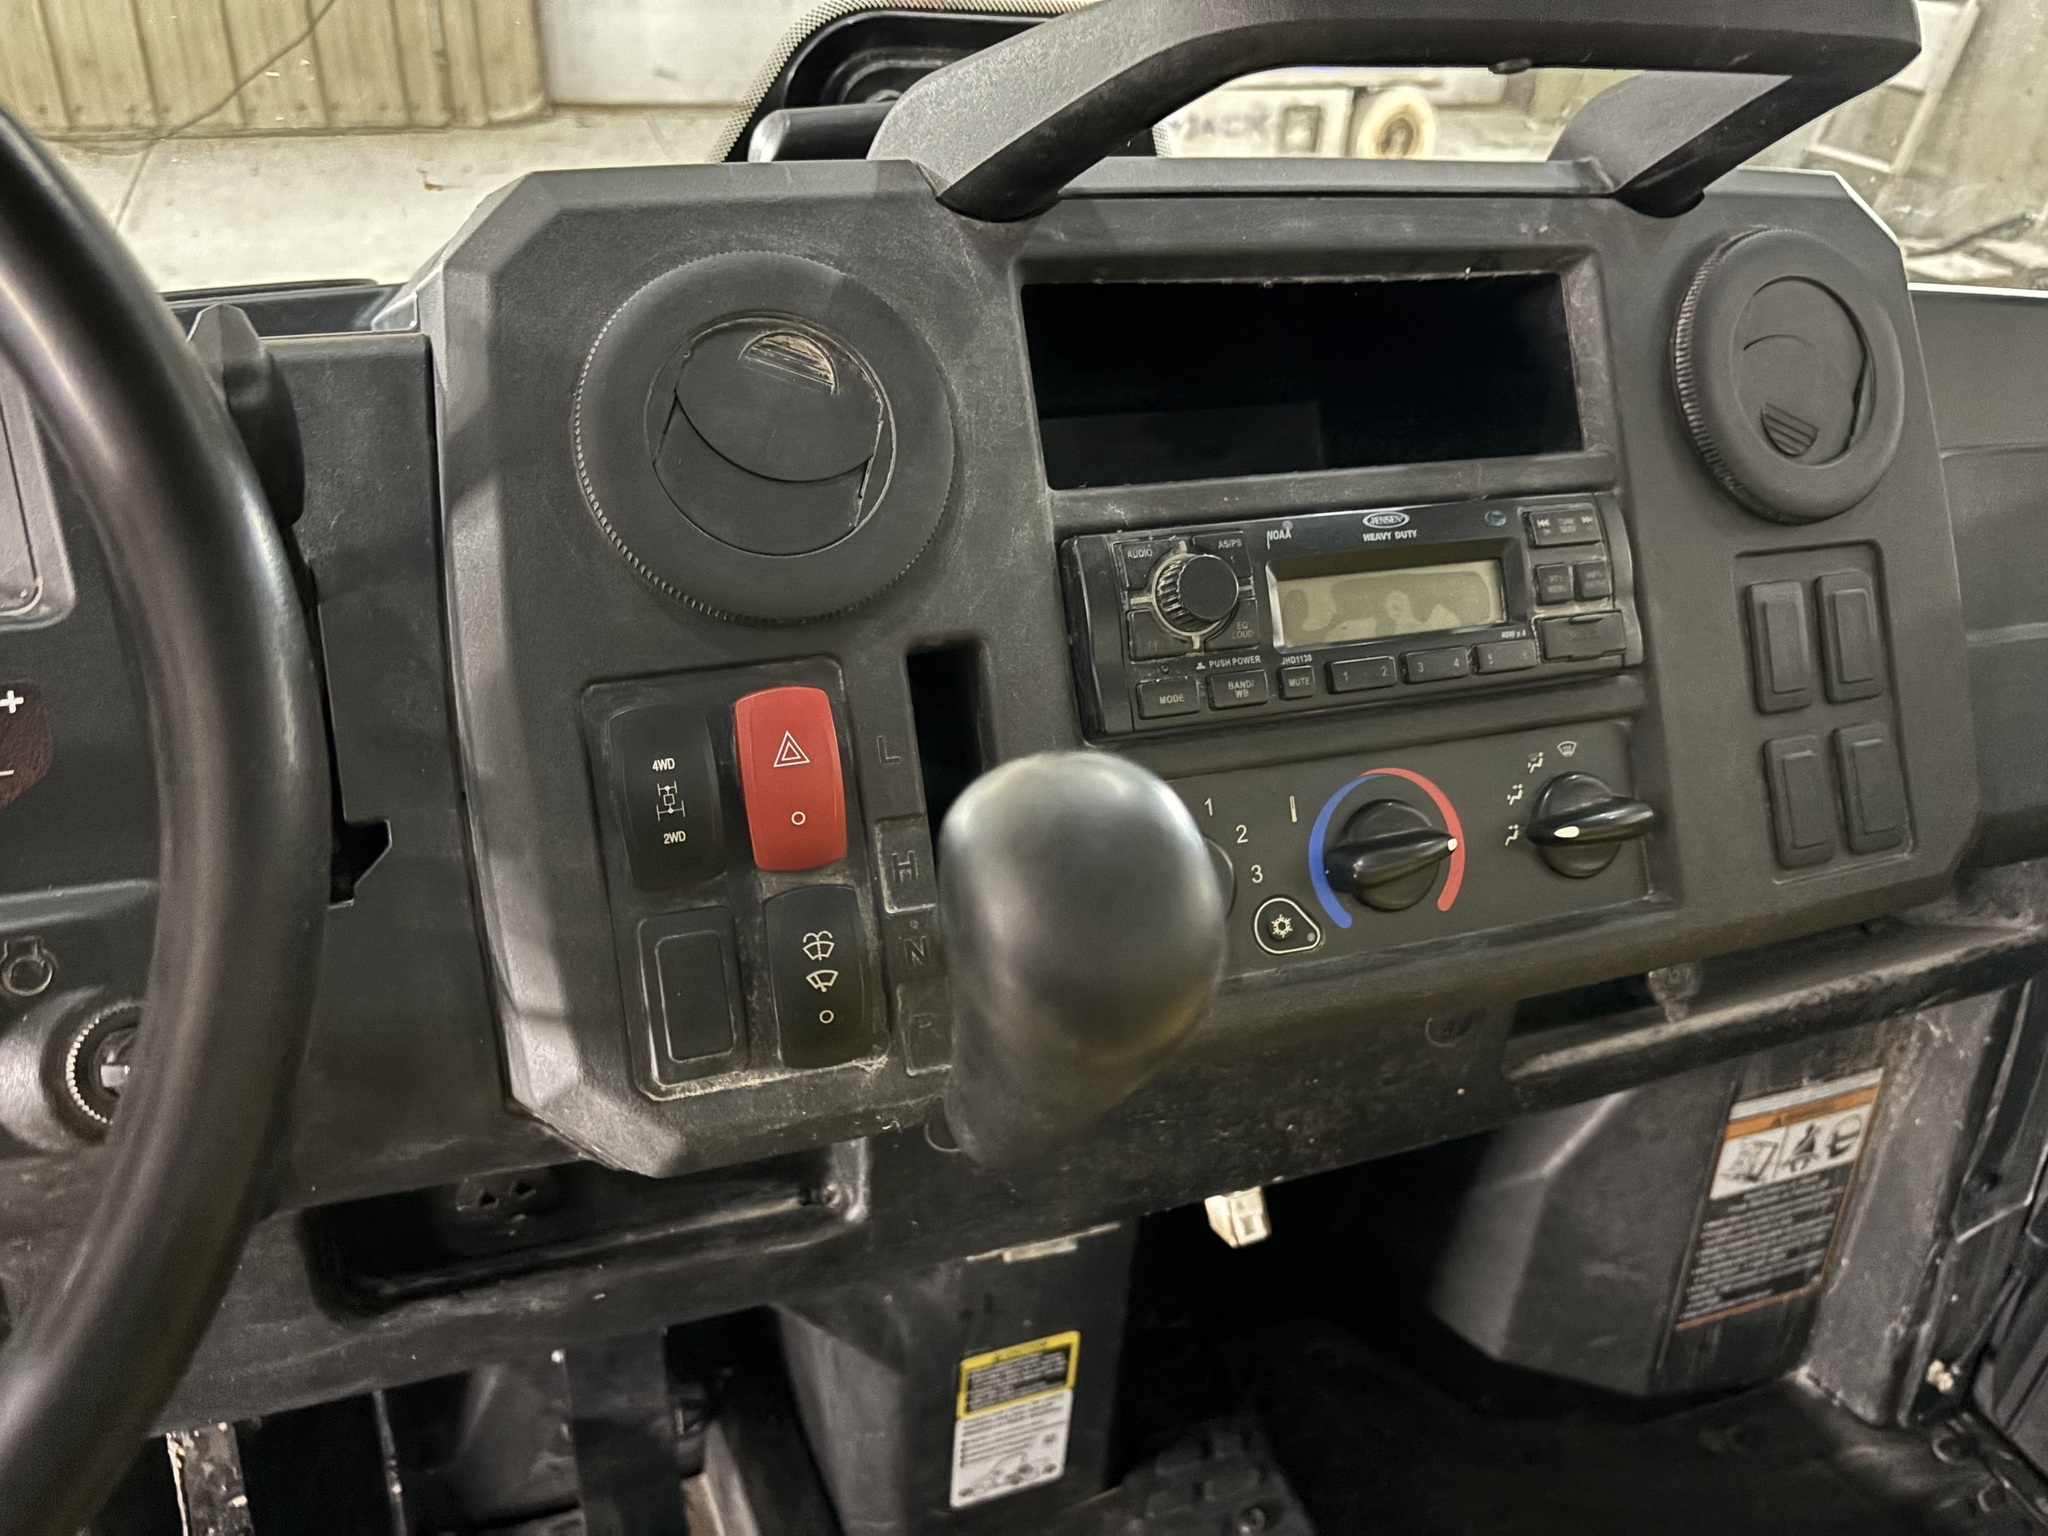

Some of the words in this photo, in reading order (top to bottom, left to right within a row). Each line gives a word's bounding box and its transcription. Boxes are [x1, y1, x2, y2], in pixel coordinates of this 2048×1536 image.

[1369, 515, 1402, 526] JENSEN
[1266, 527, 1292, 549] NOAA
[1362, 531, 1391, 542] HEAVY
[1394, 529, 1417, 539] DUTY
[1127, 548, 1153, 559] AUDIO
[1208, 658, 1231, 669] PUSH
[1232, 655, 1262, 666] POWER
[1453, 657, 1460, 668] 4
[1487, 654, 1494, 665] 5
[1381, 665, 1388, 677] 2
[1417, 662, 1424, 672] 3
[1288, 676, 1311, 688] MUTE
[1159, 694, 1185, 705] MODE
[1235, 689, 1249, 699] WB
[877, 735, 901, 765] L
[652, 757, 676, 772] 4WD
[1204, 797, 1213, 816] 1
[663, 830, 687, 845] 2WD
[1235, 824, 1249, 844] 2
[892, 850, 919, 882] H
[1251, 864, 1264, 884] 3
[904, 935, 931, 969] N
